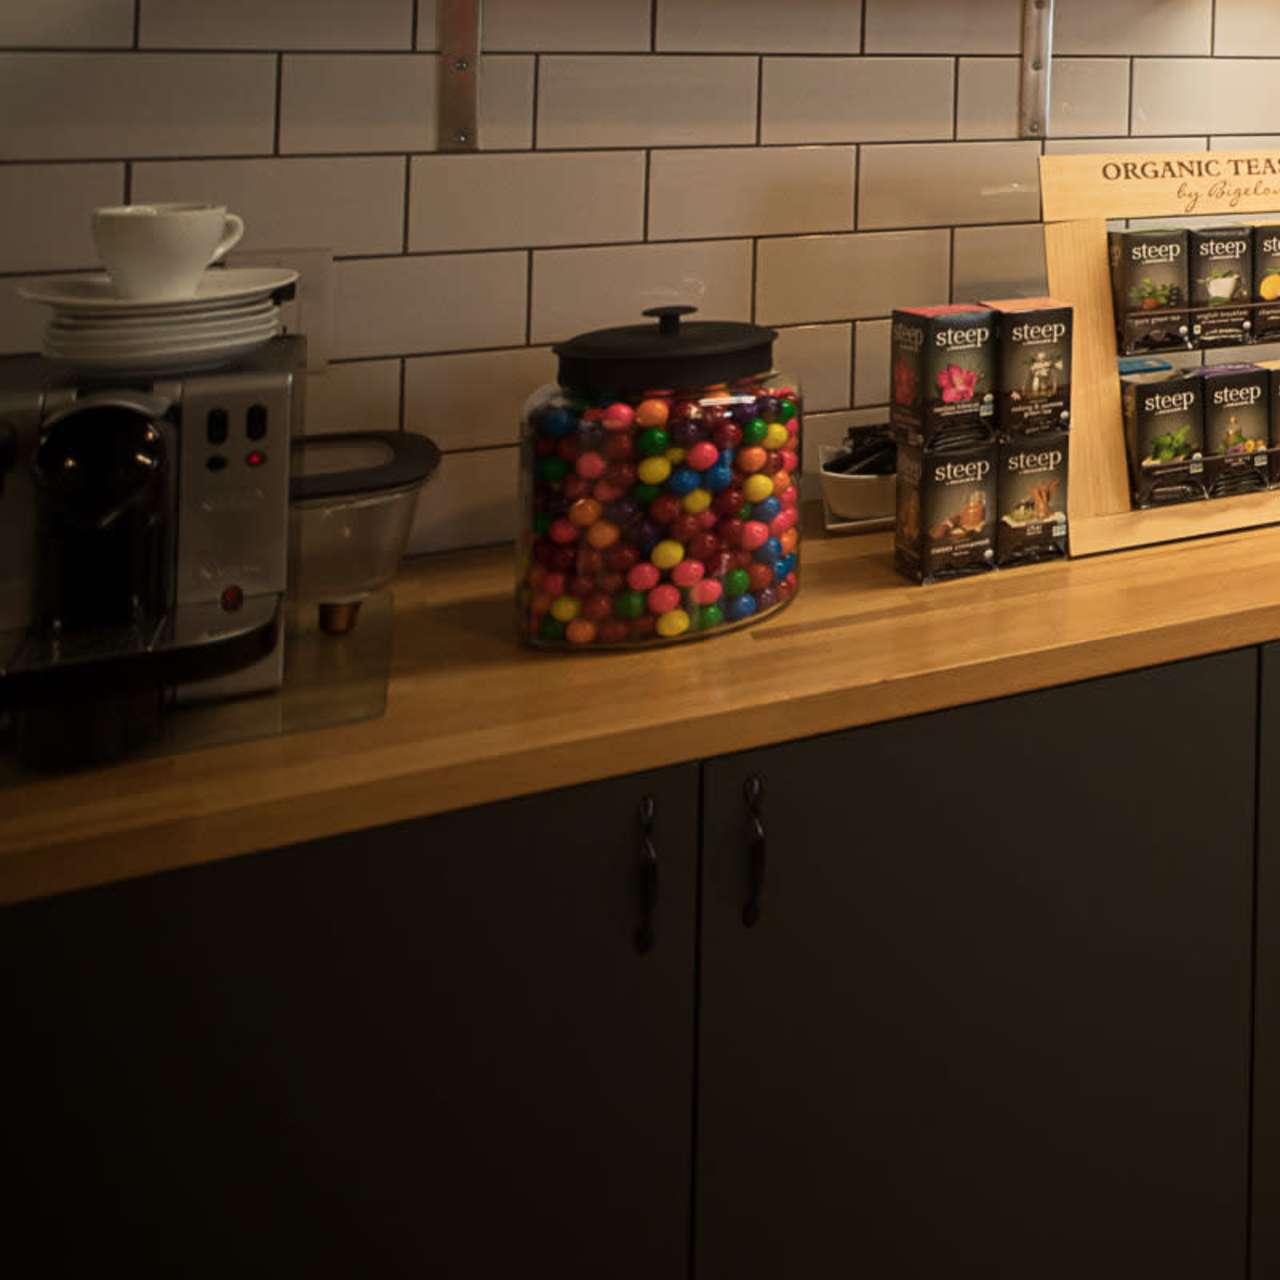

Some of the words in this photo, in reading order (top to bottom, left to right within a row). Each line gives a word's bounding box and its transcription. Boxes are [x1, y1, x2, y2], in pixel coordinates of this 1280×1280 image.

[1102, 159, 1220, 181] ORGANIC
[1177, 181, 1201, 213] by
[1132, 241, 1181, 262] steep
[1200, 238, 1247, 257] steep
[936, 326, 990, 348] steep
[1012, 322, 1066, 344] steep
[1145, 391, 1195, 412] steep
[1213, 384, 1262, 405] steep
[935, 459, 990, 482] steep
[1008, 450, 1063, 472] steep
